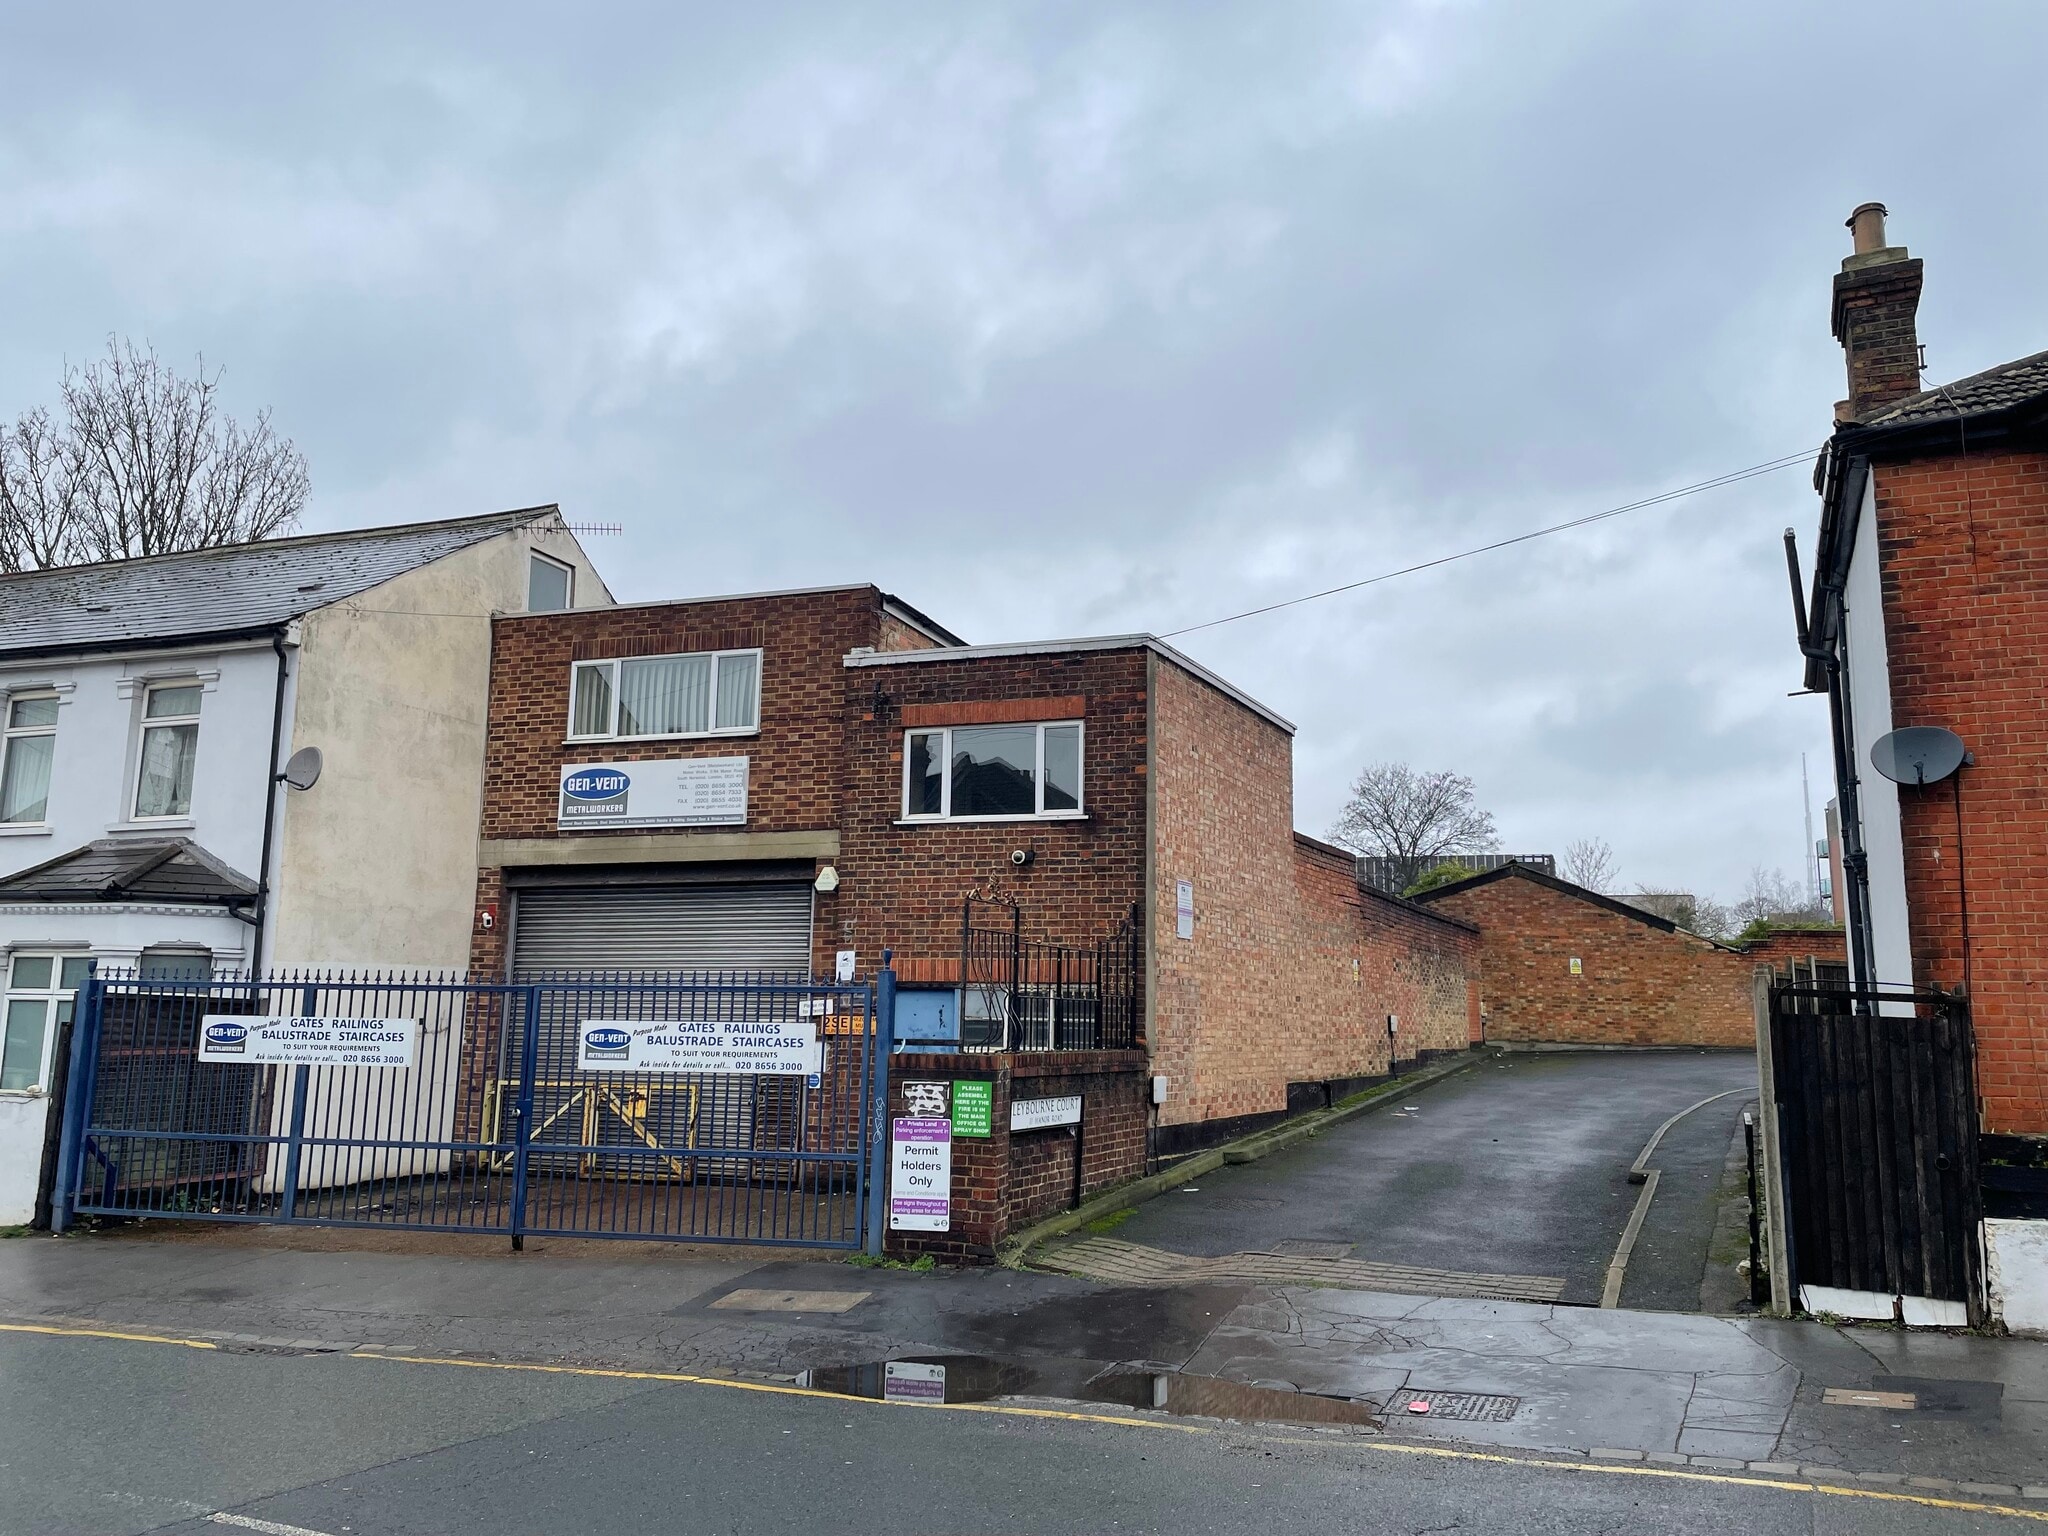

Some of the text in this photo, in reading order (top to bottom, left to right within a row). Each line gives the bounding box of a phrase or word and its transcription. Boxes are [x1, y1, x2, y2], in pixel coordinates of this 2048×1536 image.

[567, 776, 626, 791] GEN-VENT
[566, 804, 624, 814] METALWORKERS
[290, 1018, 384, 1029] GATES RAILINGS
[653, 1023, 668, 1032] Made
[678, 1022, 781, 1034] GATES RAILINGS
[209, 1027, 245, 1037] GEN-VENT
[262, 1030, 404, 1042] BALUSTRADE STAIRCASES
[588, 1033, 628, 1043] GEN-VENT
[647, 1035, 804, 1048] BALUSTRADE STAIRCASES
[330, 1044, 380, 1052] REQUIREMENTS
[284, 1053, 293, 1061] for
[294, 1053, 312, 1061] details
[343, 1054, 404, 1064] 020 8656 3000
[671, 1049, 680, 1057] TO
[700, 1050, 720, 1058] YOUR
[722, 1051, 778, 1059] REQUIREMENTS
[639, 1060, 650, 1068] Ask
[652, 1060, 670, 1068] inside
[671, 1061, 681, 1069] for
[682, 1061, 703, 1069] details
[735, 1061, 803, 1071] 020 8656 3000
[1012, 1097, 1079, 1116] LEYBOURNE COURT
[904, 1145, 939, 1155] Permit
[901, 1160, 942, 1171] Holders
[909, 1175, 933, 1188] Only
[916, 1200, 941, 1208] throughout
